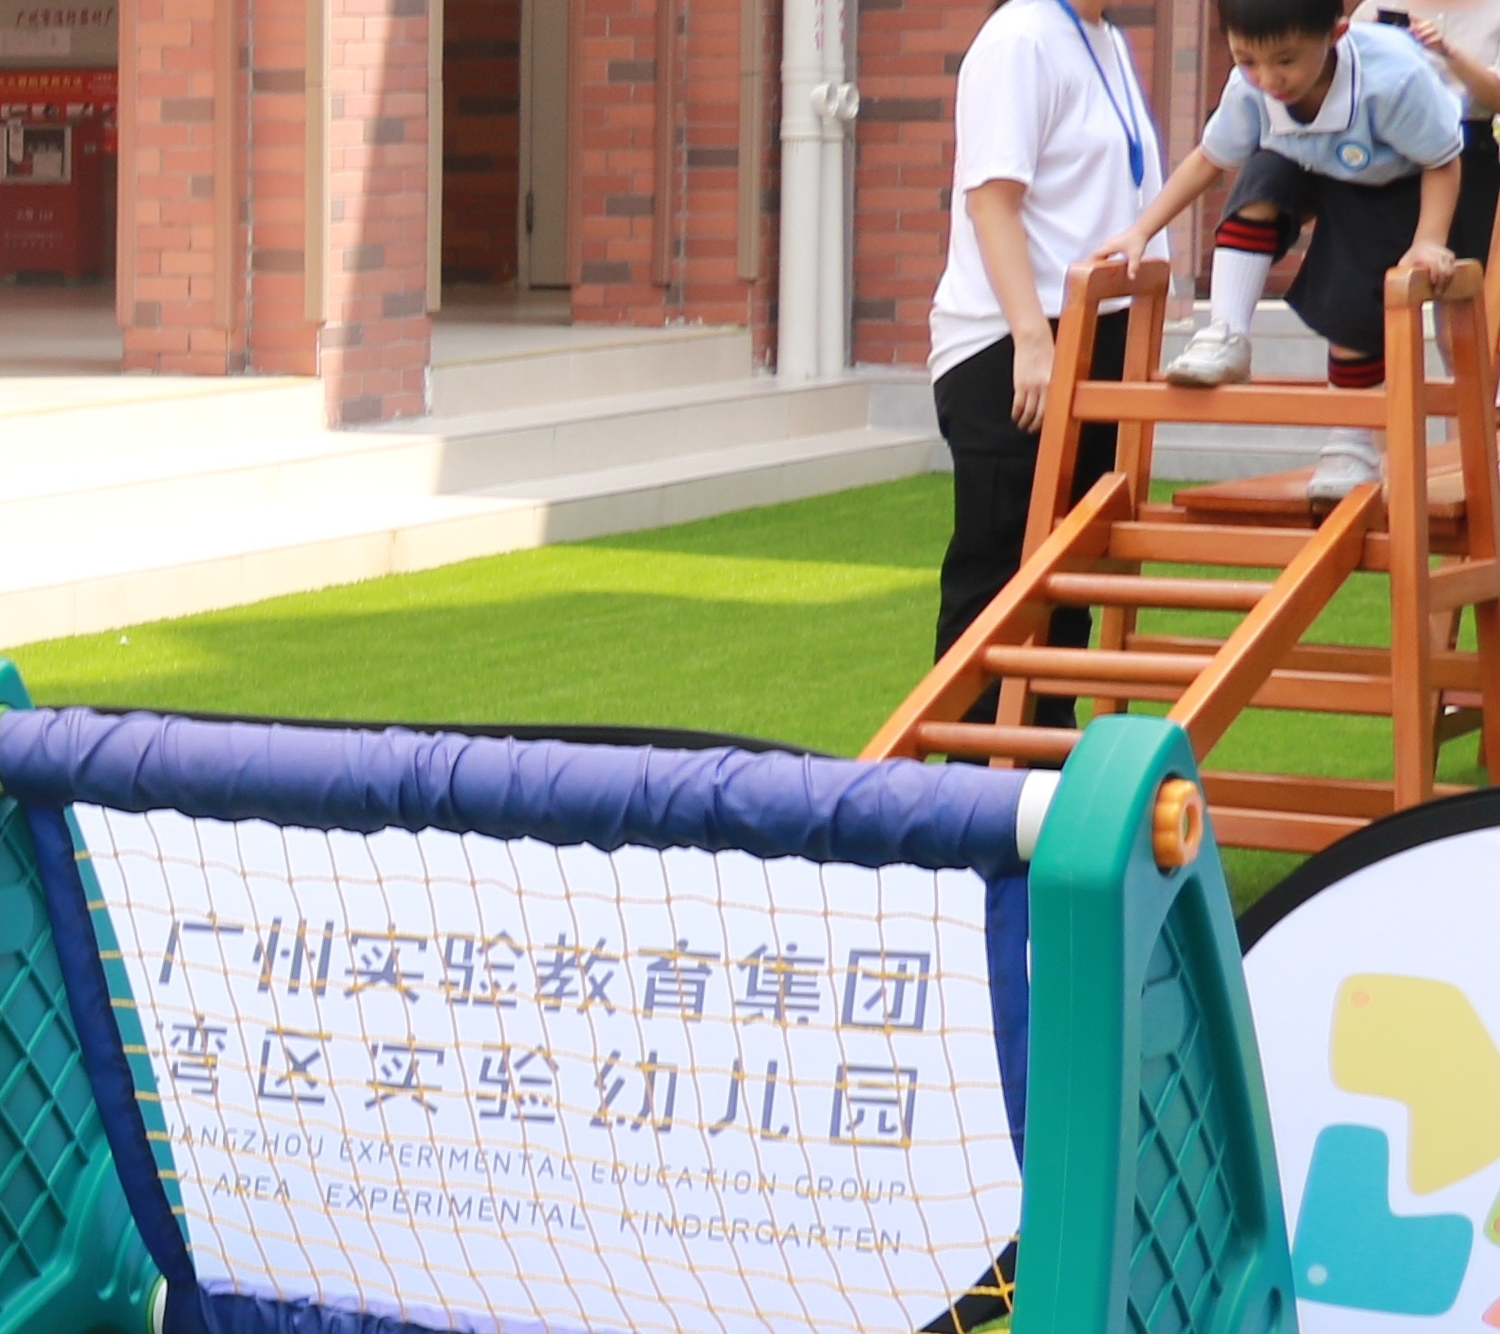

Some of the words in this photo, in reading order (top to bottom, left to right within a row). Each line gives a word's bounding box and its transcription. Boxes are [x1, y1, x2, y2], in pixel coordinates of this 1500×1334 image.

[159, 917, 931, 1032] 广州实验教育集团
[155, 1013, 920, 1149] 湾区实验幼儿园
[212, 1172, 291, 1201] AREA
[326, 1182, 587, 1232] EXPERIMENTAL
[620, 1209, 902, 1255] KINDERGARTEN
[339, 1138, 574, 1181] EXPERIMENTAL
[591, 1160, 777, 1196] EDUCATION
[794, 1174, 907, 1205] GROUP
